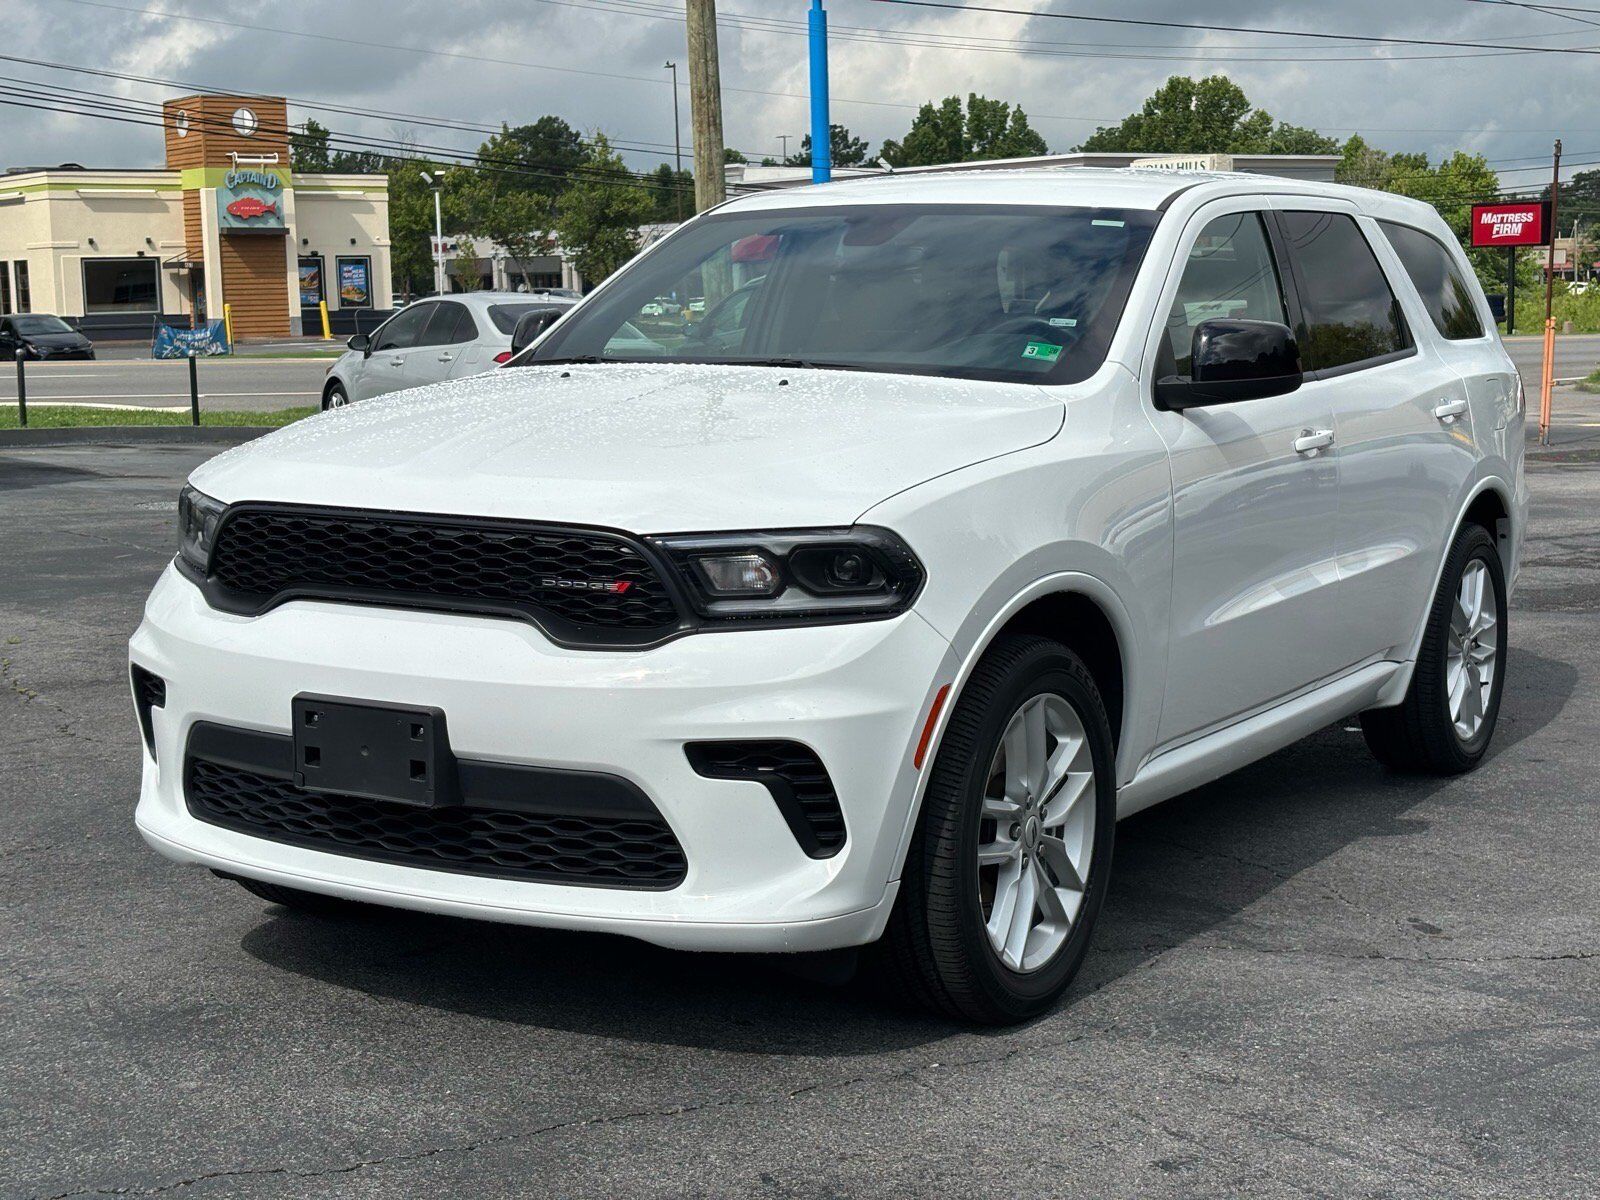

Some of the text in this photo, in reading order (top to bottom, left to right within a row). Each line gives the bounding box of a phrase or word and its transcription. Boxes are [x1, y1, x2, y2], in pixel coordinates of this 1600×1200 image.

[1481, 213, 1534, 224] MATTRESS
[1492, 223, 1523, 235] FIRM
[1028, 347, 1035, 355] 3
[542, 579, 619, 590] DODGE
